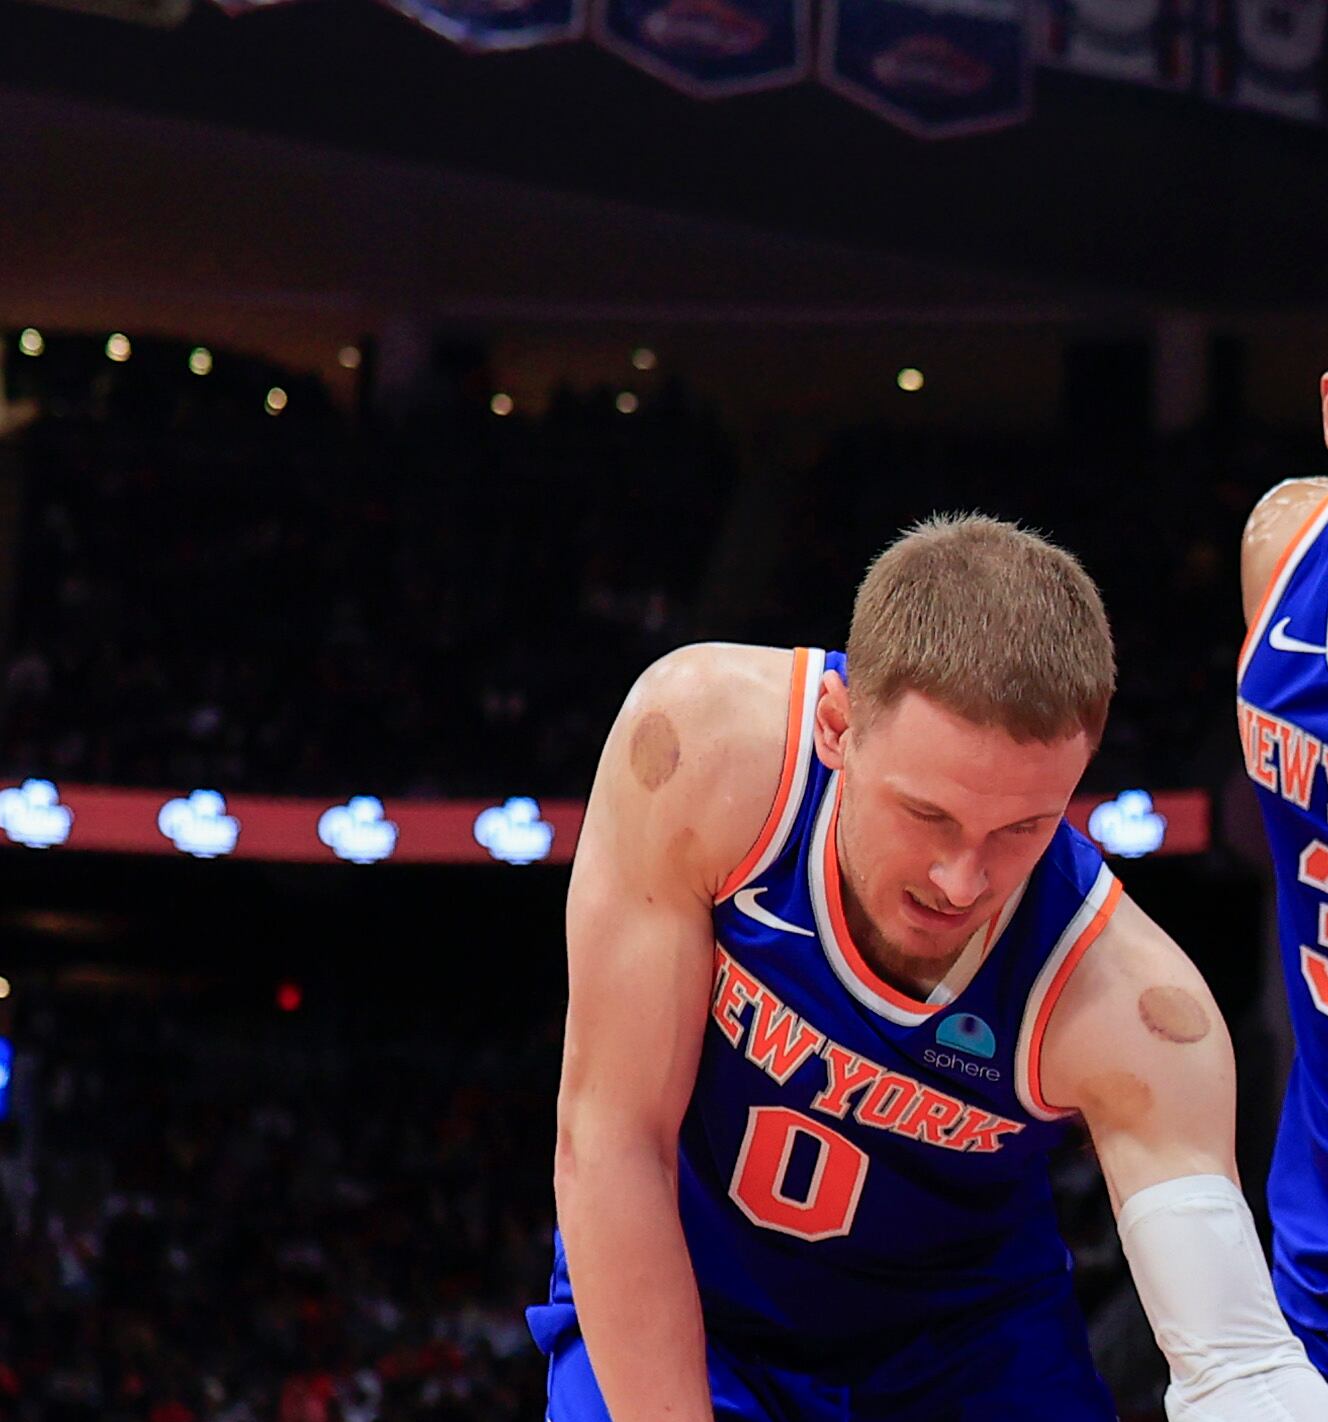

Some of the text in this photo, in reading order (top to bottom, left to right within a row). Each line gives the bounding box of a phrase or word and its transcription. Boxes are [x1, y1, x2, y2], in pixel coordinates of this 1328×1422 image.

[810, 1039, 1026, 1153] YORK
[923, 1049, 1001, 1082] sphere
[728, 1106, 870, 1242] 0
